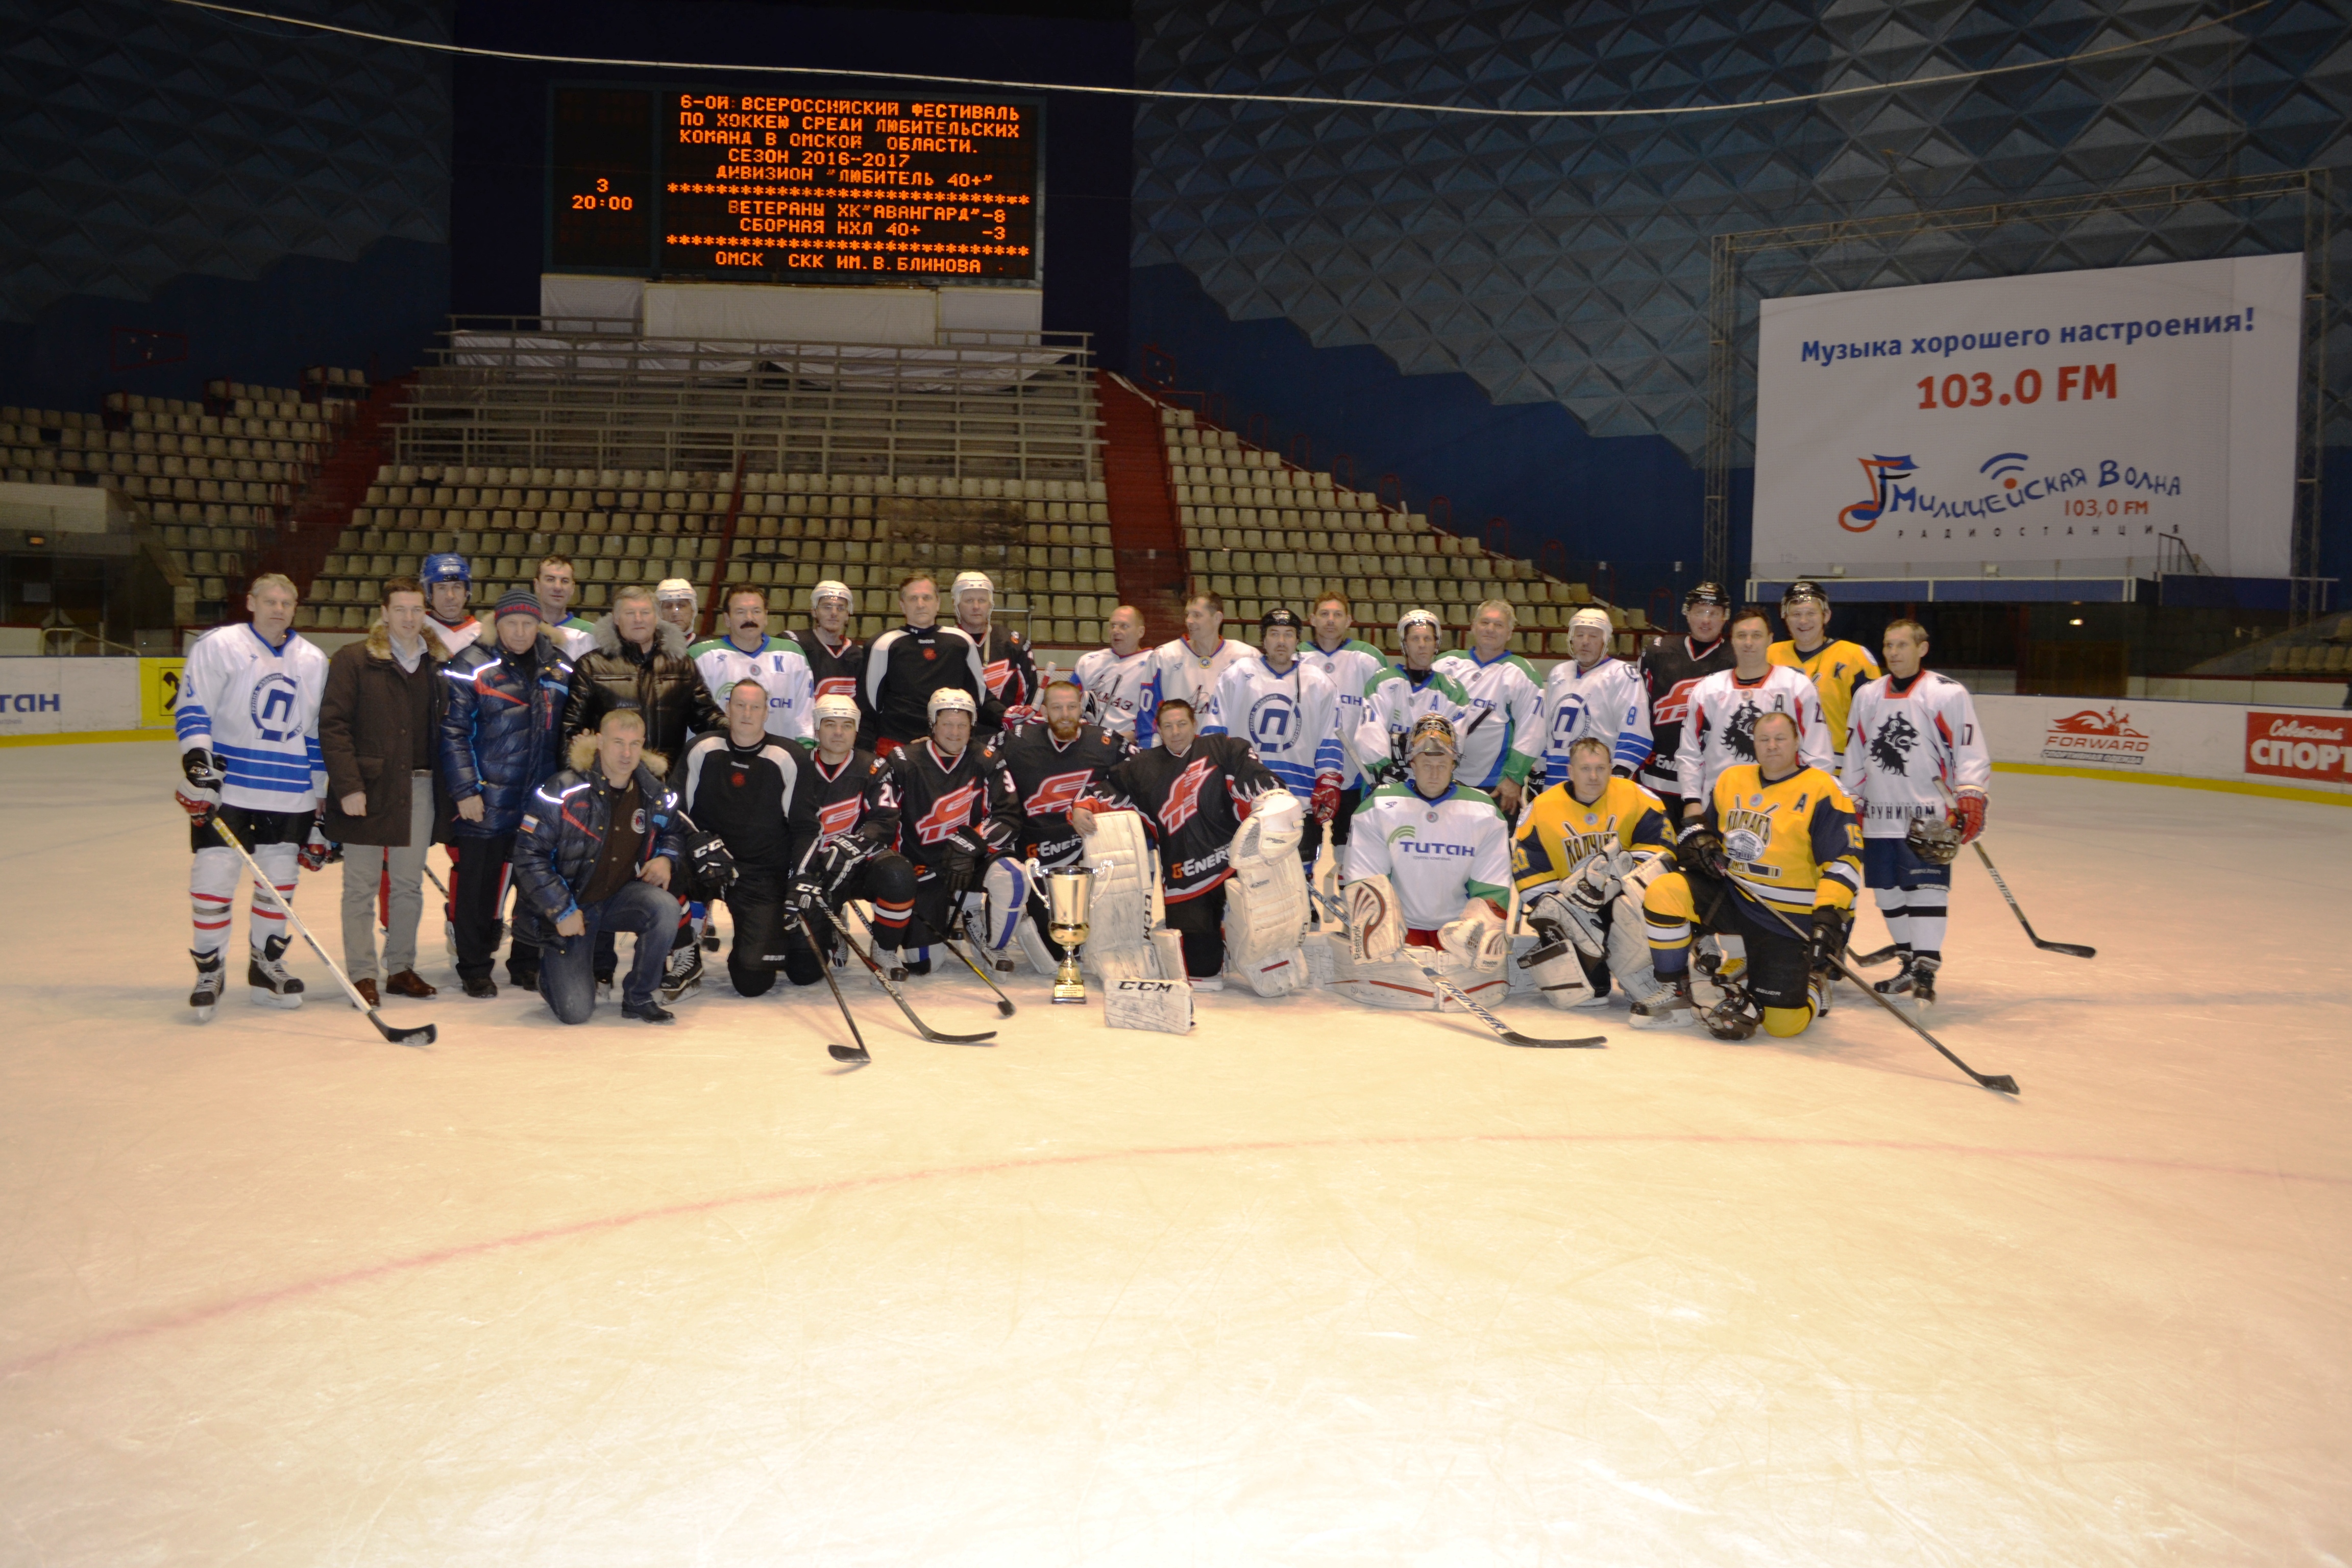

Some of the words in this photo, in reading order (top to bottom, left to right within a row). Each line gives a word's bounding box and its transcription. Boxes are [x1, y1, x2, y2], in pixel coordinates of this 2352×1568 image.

[912, 103, 1019, 121] ФЕСТИВАЛЬ
[680, 112, 704, 126] ПО
[802, 116, 863, 132] СРЕДИ
[875, 118, 1019, 139] ЛЮБИТЕЛЬСКИХ
[680, 129, 752, 145] КОМАНД
[765, 132, 777, 146] В
[887, 136, 977, 153] ОБЛАСТИ.
[728, 148, 789, 163] СЕЗОН
[801, 150, 910, 169] 2016-2017
[716, 165, 813, 181] ДИВИЗИОН
[597, 178, 608, 192] 3
[572, 195, 632, 210] 20:00
[728, 200, 825, 216] ВЕТЕРАНЫ
[740, 217, 825, 234] СБОРНАЯ
[837, 220, 873, 235] НХЛ
[886, 222, 921, 236] 40+
[716, 251, 763, 266] ОМСК
[789, 254, 824, 268] СКК
[1801, 340, 1902, 367] Музыка
[1911, 328, 2050, 357] хорошего
[2060, 307, 2255, 346] настроения!
[1917, 369, 2042, 409] 103.0
[2057, 363, 2116, 402] FM
[2124, 500, 2149, 515] FM
[1897, 524, 2179, 539] РАДИОСТАНЦИЯ
[1626, 706, 1636, 726] 8
[2045, 736, 2149, 752] FORWARD
[1354, 924, 1362, 961] Reebok
[1118, 981, 1173, 993] CCM
